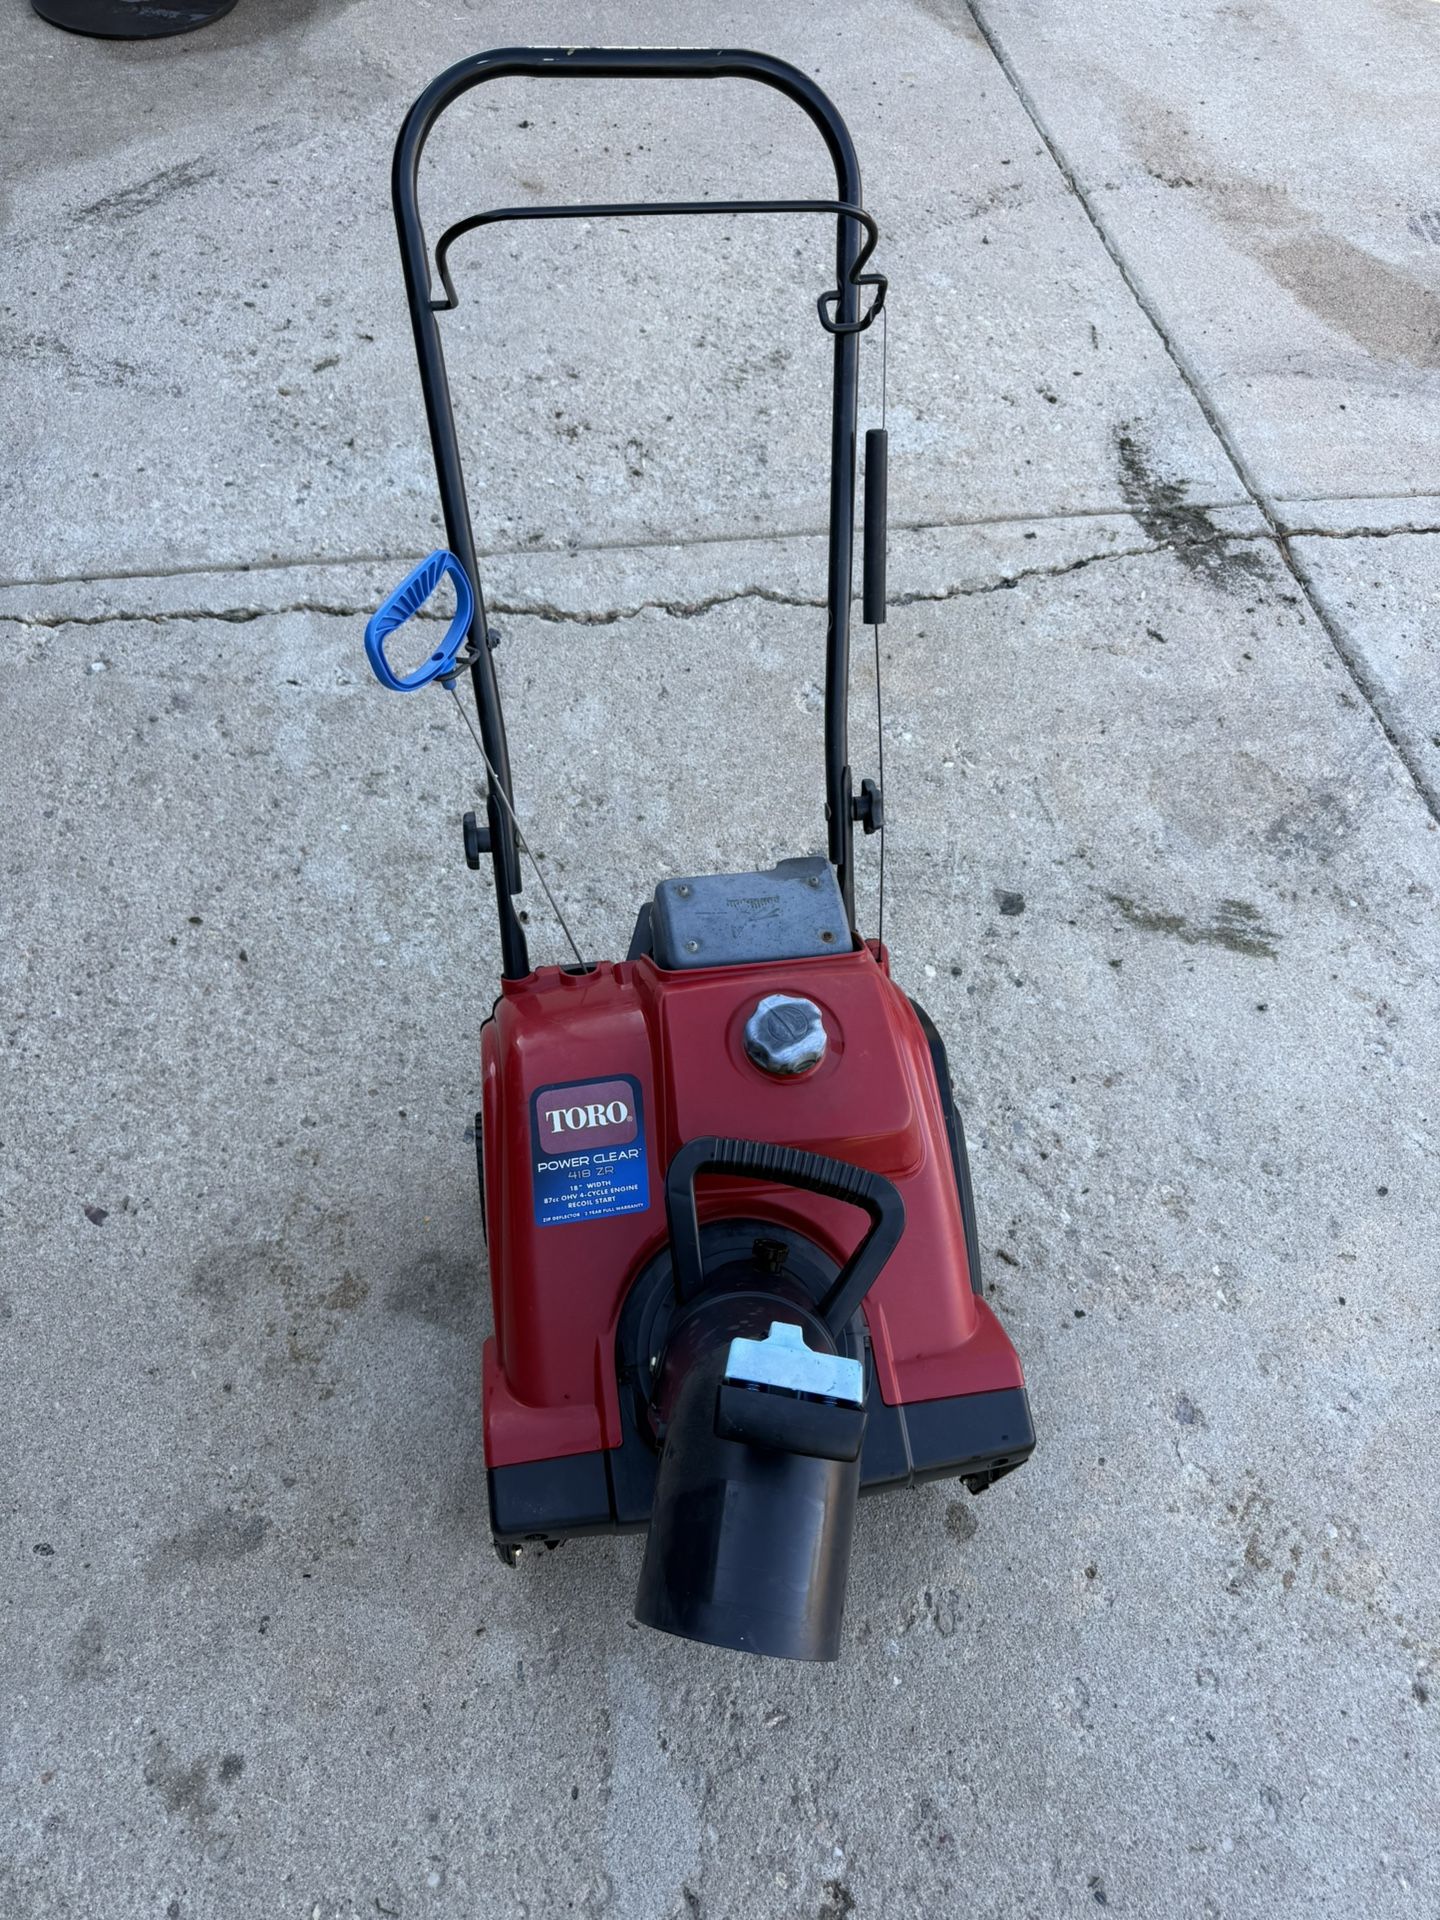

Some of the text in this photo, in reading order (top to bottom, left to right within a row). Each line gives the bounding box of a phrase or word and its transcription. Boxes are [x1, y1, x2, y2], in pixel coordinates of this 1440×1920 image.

[546, 1100, 628, 1134] TORO
[538, 1149, 640, 1172] POWER CLEAR
[568, 1166, 614, 1179] 418 ZR
[580, 1190, 608, 1198] 4-CYCLE
[610, 1184, 638, 1194] ENGINE
[586, 1180, 611, 1189] WIDTH
[568, 1196, 616, 1208] RECOIL START
[552, 1212, 580, 1221] DEFLECTOR
